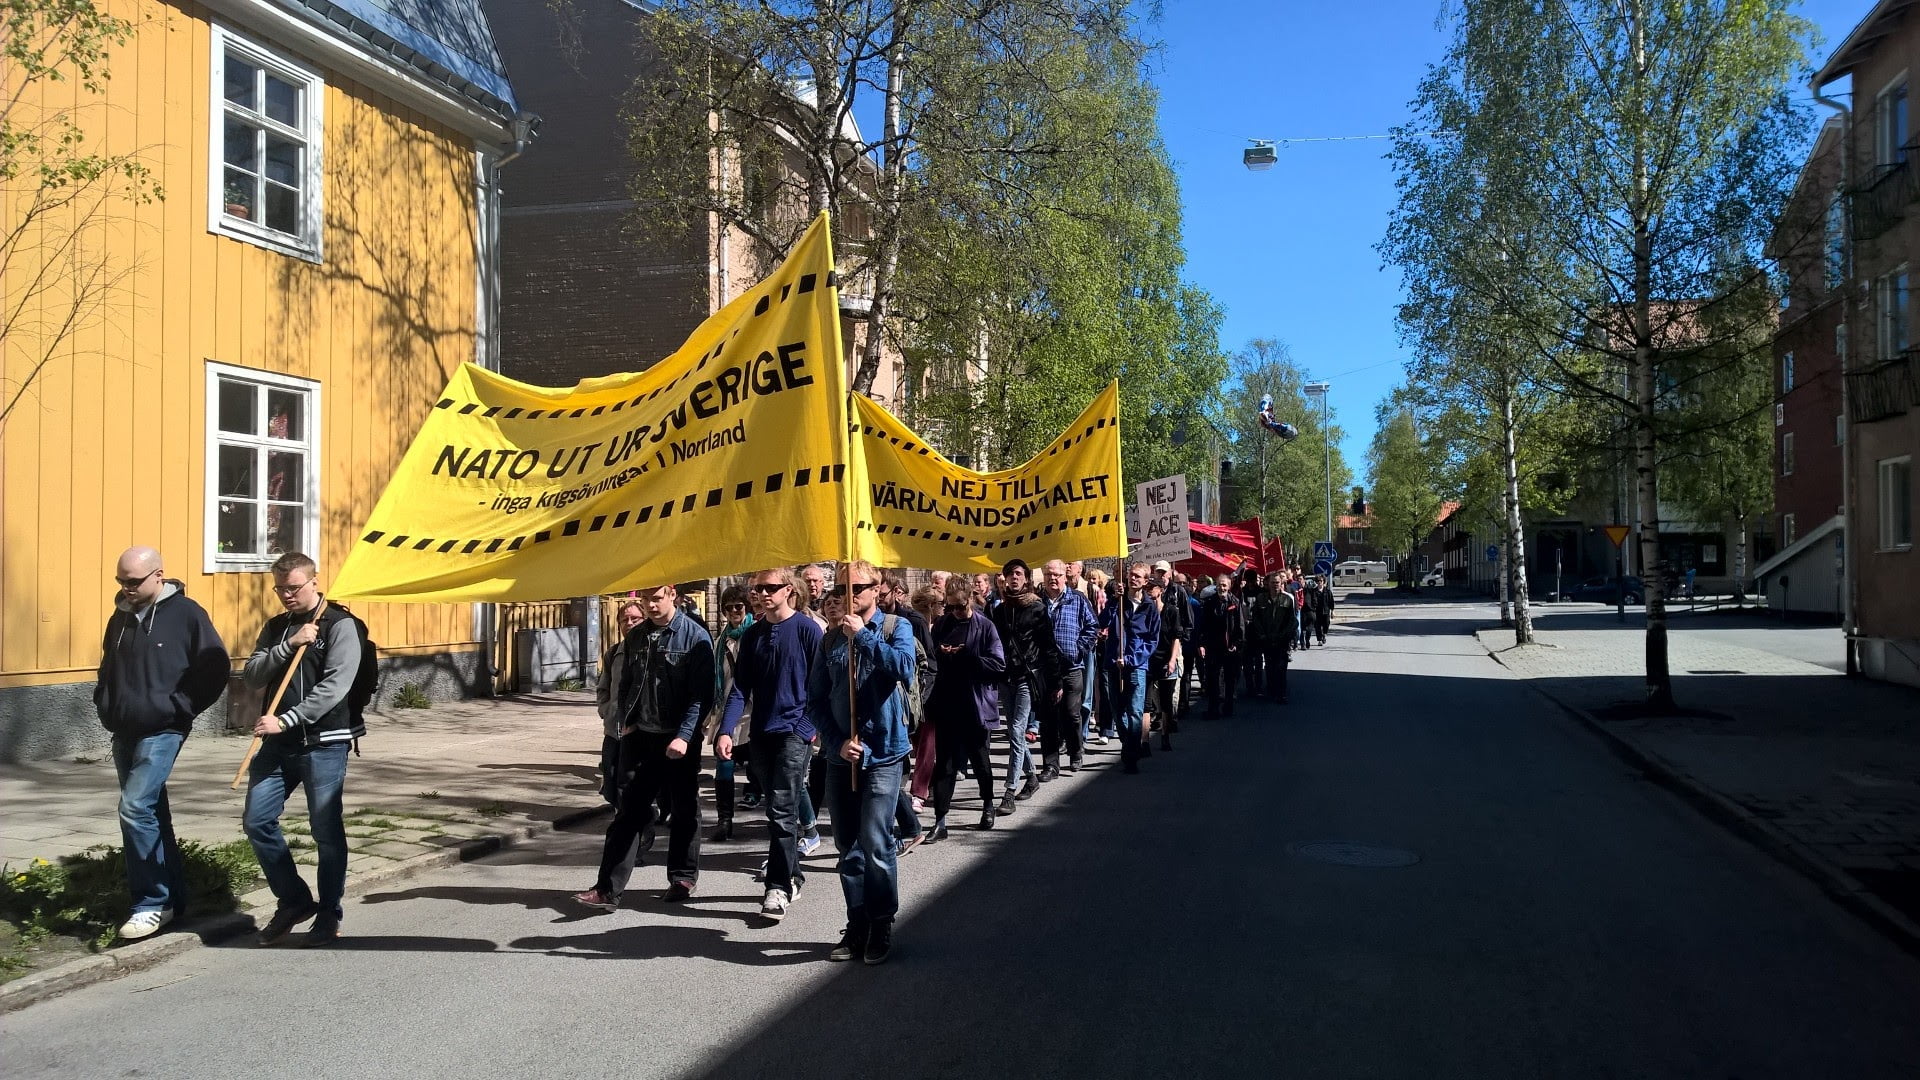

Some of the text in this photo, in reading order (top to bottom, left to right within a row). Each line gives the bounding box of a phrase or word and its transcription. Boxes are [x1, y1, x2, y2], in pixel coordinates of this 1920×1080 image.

[431, 341, 814, 480] NATO UT UR SVERIGE
[490, 492, 532, 515] inga
[669, 418, 747, 465] Norrland
[941, 475, 1047, 501] NEJ TILL
[1145, 481, 1177, 507] NEJ
[1152, 503, 1174, 516] TILL
[1146, 514, 1181, 539] ACE
